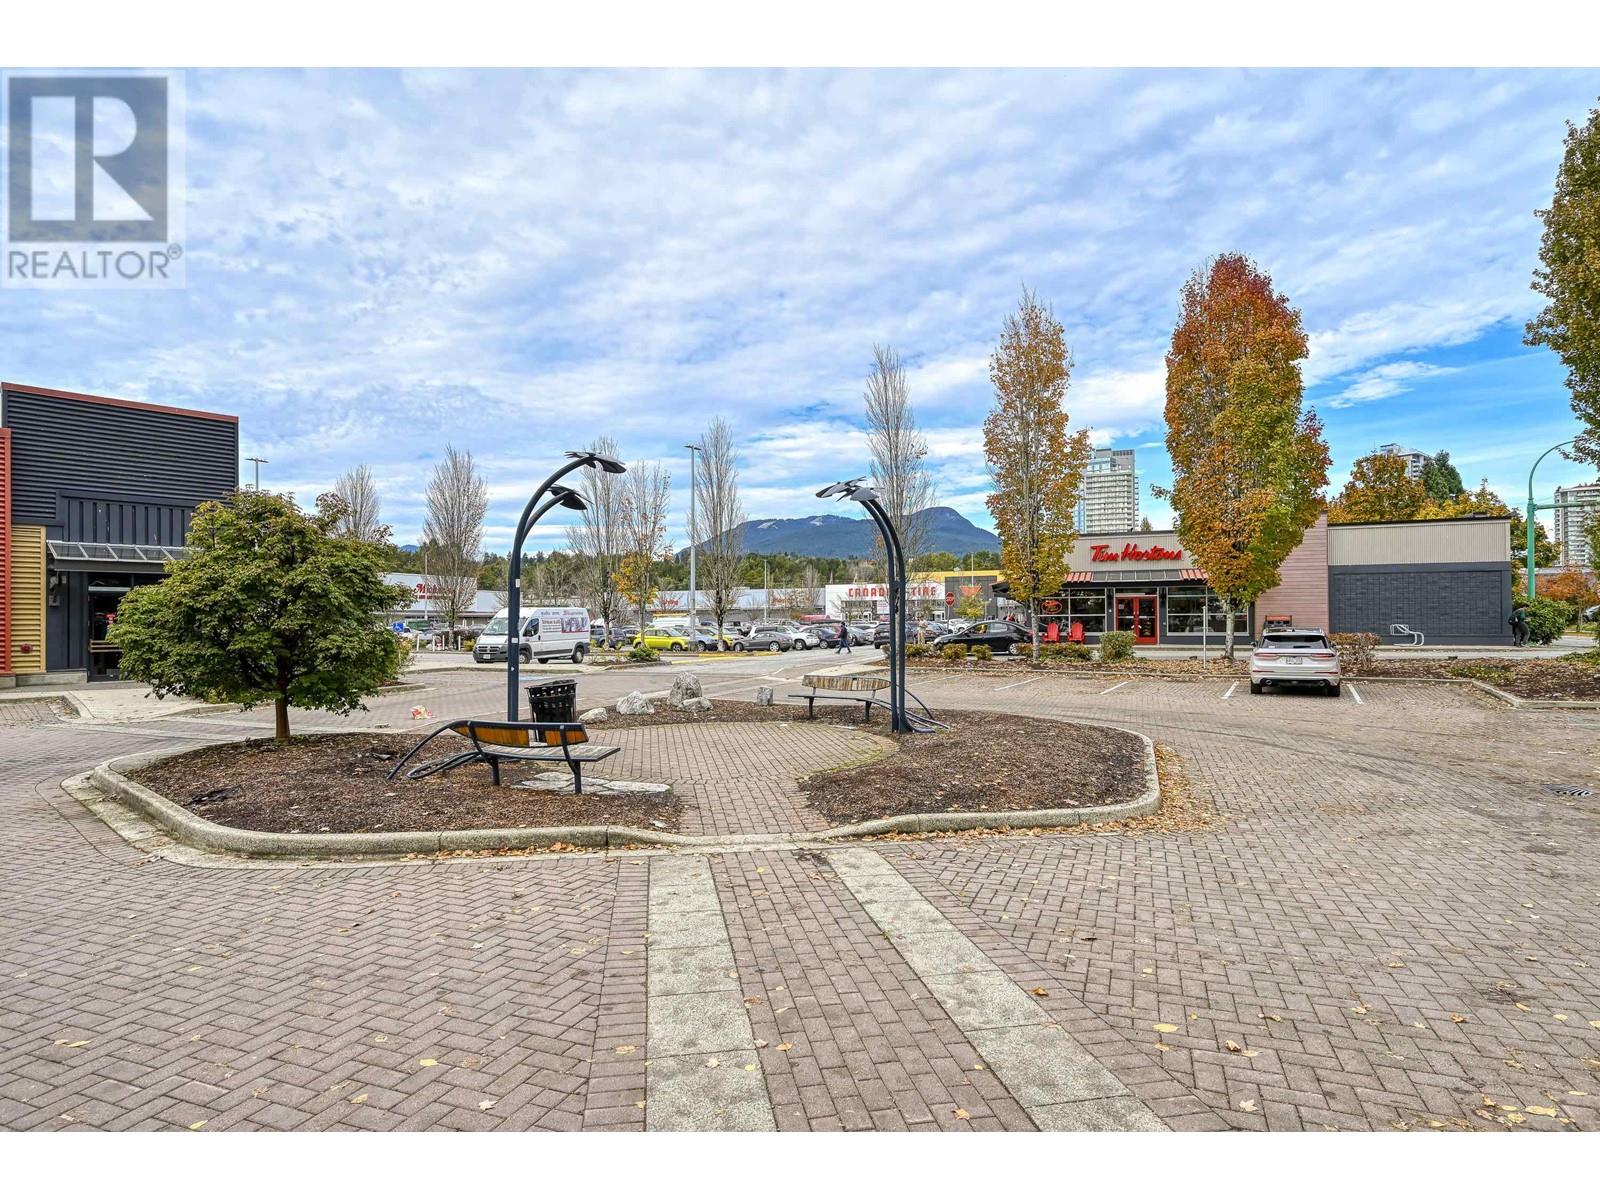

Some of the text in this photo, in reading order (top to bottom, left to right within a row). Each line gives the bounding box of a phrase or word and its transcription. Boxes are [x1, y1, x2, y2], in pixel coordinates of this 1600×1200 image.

[1090, 543, 1182, 562] Tim Hortons
[911, 586, 936, 597] TIRE
